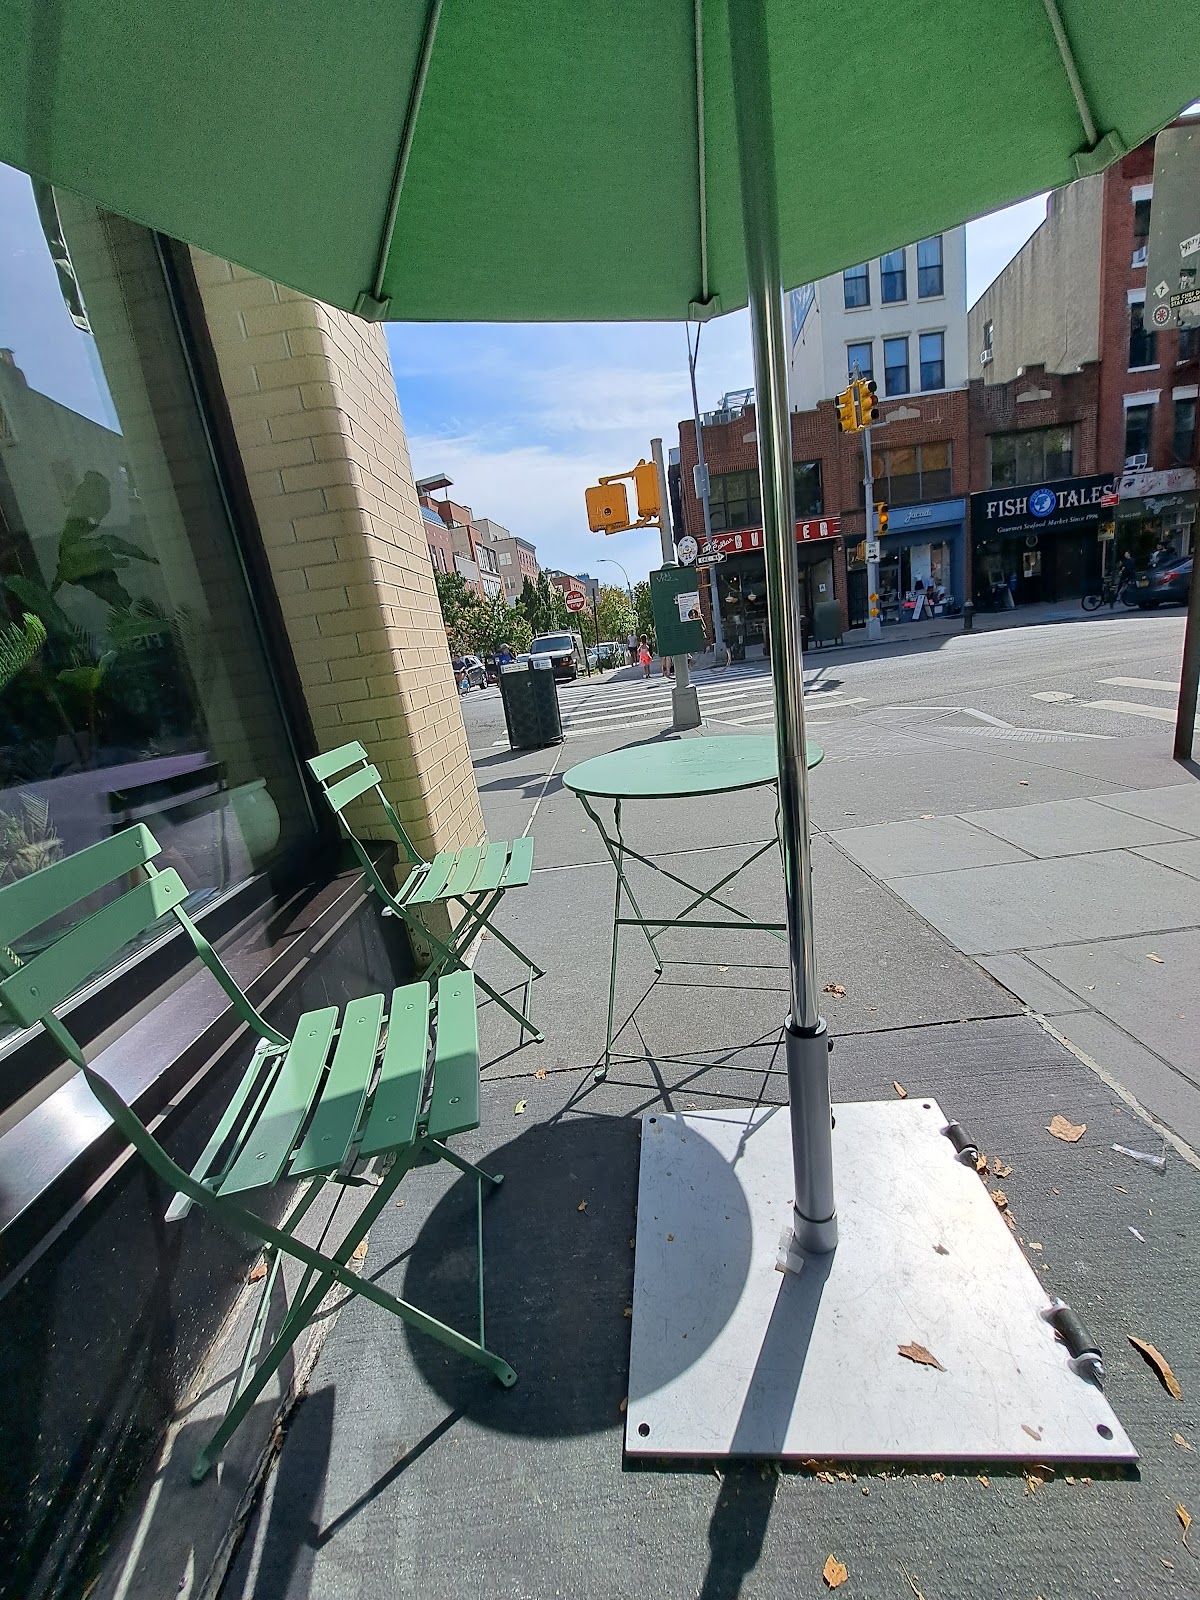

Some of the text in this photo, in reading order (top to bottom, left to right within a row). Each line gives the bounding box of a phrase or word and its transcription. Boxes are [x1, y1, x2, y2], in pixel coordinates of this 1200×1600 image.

[986, 497, 1028, 519] FISH
[1056, 485, 1112, 509] TALES
[997, 523, 1022, 533] Gourmet
[1023, 520, 1046, 530] Seafood
[1048, 518, 1068, 526] Market
[1069, 515, 1084, 523] Since
